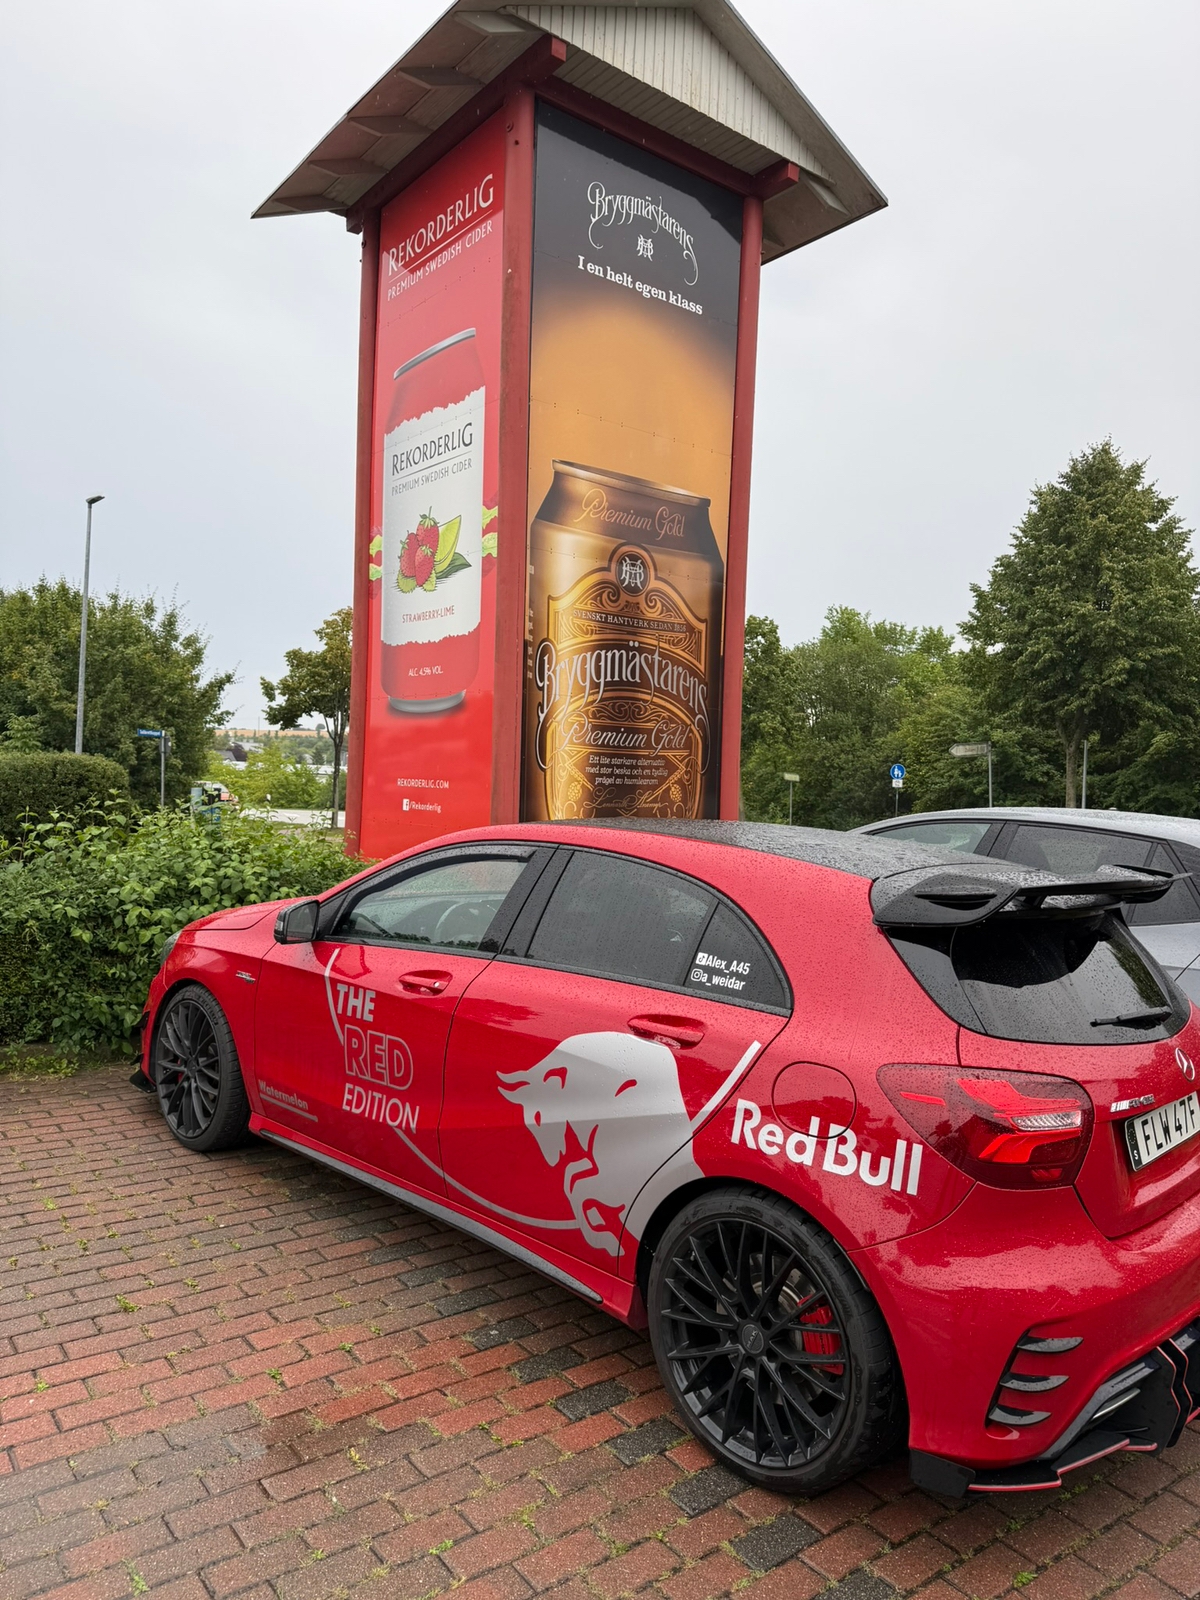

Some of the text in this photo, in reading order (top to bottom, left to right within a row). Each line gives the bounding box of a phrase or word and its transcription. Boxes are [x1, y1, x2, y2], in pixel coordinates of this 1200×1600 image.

[388, 173, 494, 276] REKORDERLIG
[587, 181, 699, 286] Bryggmästarens
[387, 220, 493, 301] PREMIUM SWEDISH CIDER
[577, 255, 703, 315] I en helt egen klass
[392, 422, 473, 476] REKORDERLIG
[391, 458, 473, 496] PREMIUM SWEDISH CIDER
[573, 488, 686, 540] Premium Gold
[402, 605, 455, 624] STRAWBERRY-LIME
[573, 609, 606, 622] SVENSKT
[607, 615, 649, 628] HANTVERK
[650, 622, 673, 632] SEDAN
[535, 634, 711, 774] Bryggmästarens
[557, 711, 691, 757] Premium Gold
[585, 765, 599, 774] med
[600, 766, 613, 775] stor
[613, 766, 631, 775] beska
[631, 768, 642, 776] och
[588, 755, 600, 764] Ett
[600, 755, 611, 765] lite
[610, 757, 636, 766] starkare
[701, 973, 746, 991] a_weidar
[705, 955, 751, 975] Alex_A45
[336, 983, 376, 1022] THE
[344, 1024, 414, 1090] RED
[258, 1079, 309, 1110] Watermelon
[342, 1083, 420, 1134] EDITION
[731, 1098, 923, 1196] Red Bull
[1141, 1108, 1172, 1157] FLW
[1173, 1095, 1196, 1137] 47F
